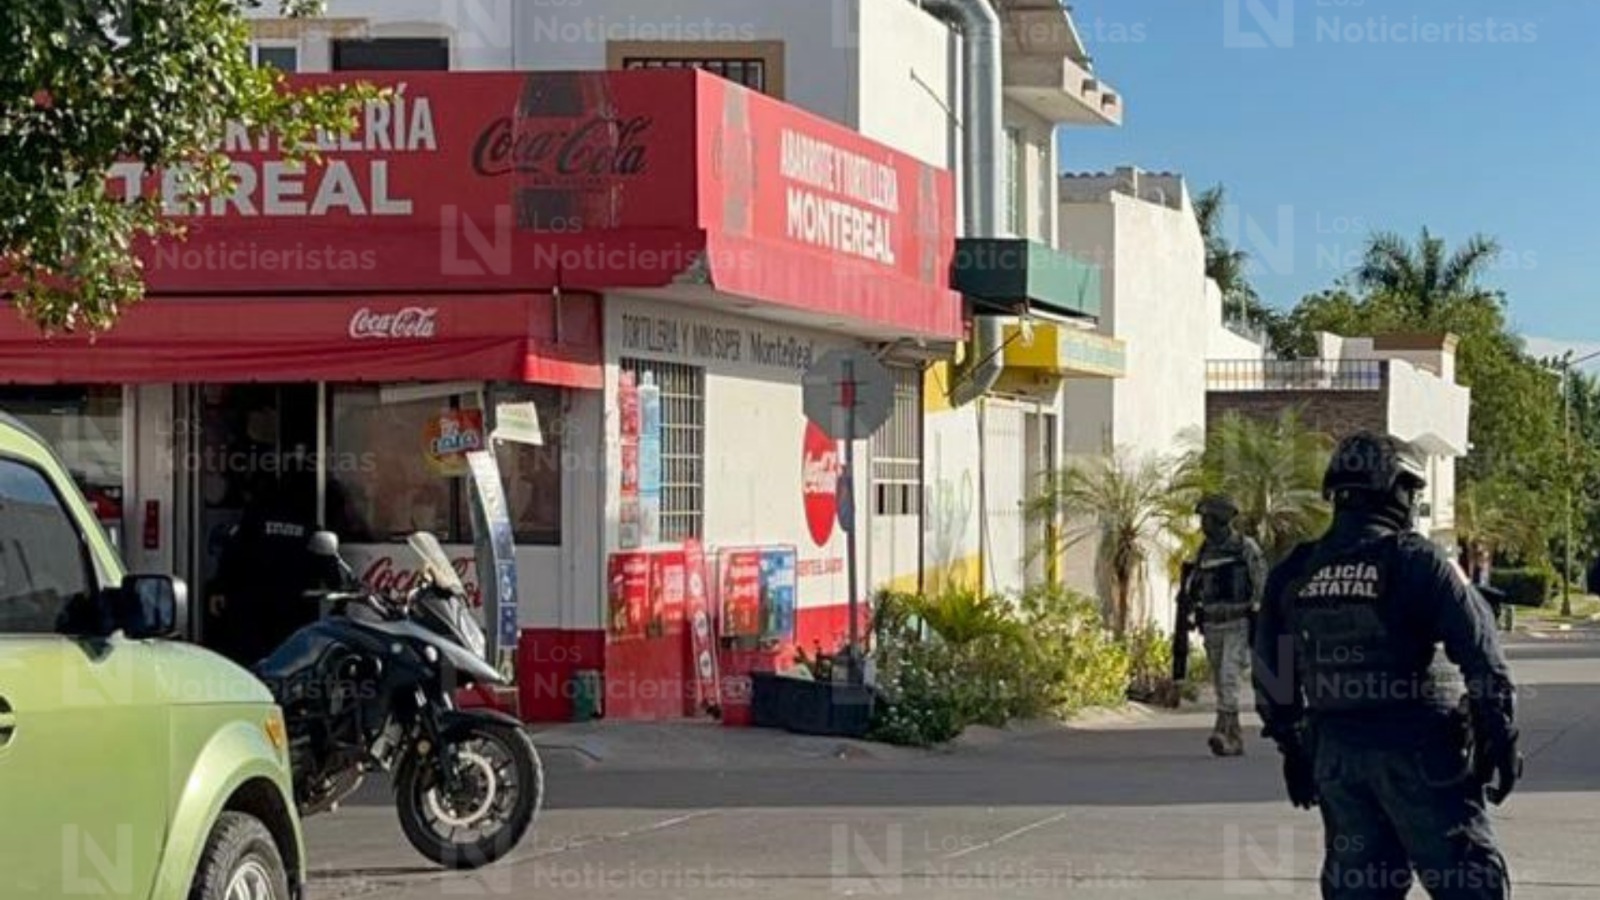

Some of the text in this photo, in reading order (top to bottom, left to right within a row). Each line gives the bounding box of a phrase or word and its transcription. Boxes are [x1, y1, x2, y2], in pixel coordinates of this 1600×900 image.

[103, 160, 412, 215] TEREAL
[786, 185, 895, 265] MONTEREAL
[349, 306, 438, 339] Coca-Cola
[1312, 561, 1379, 581] OLICÍA
